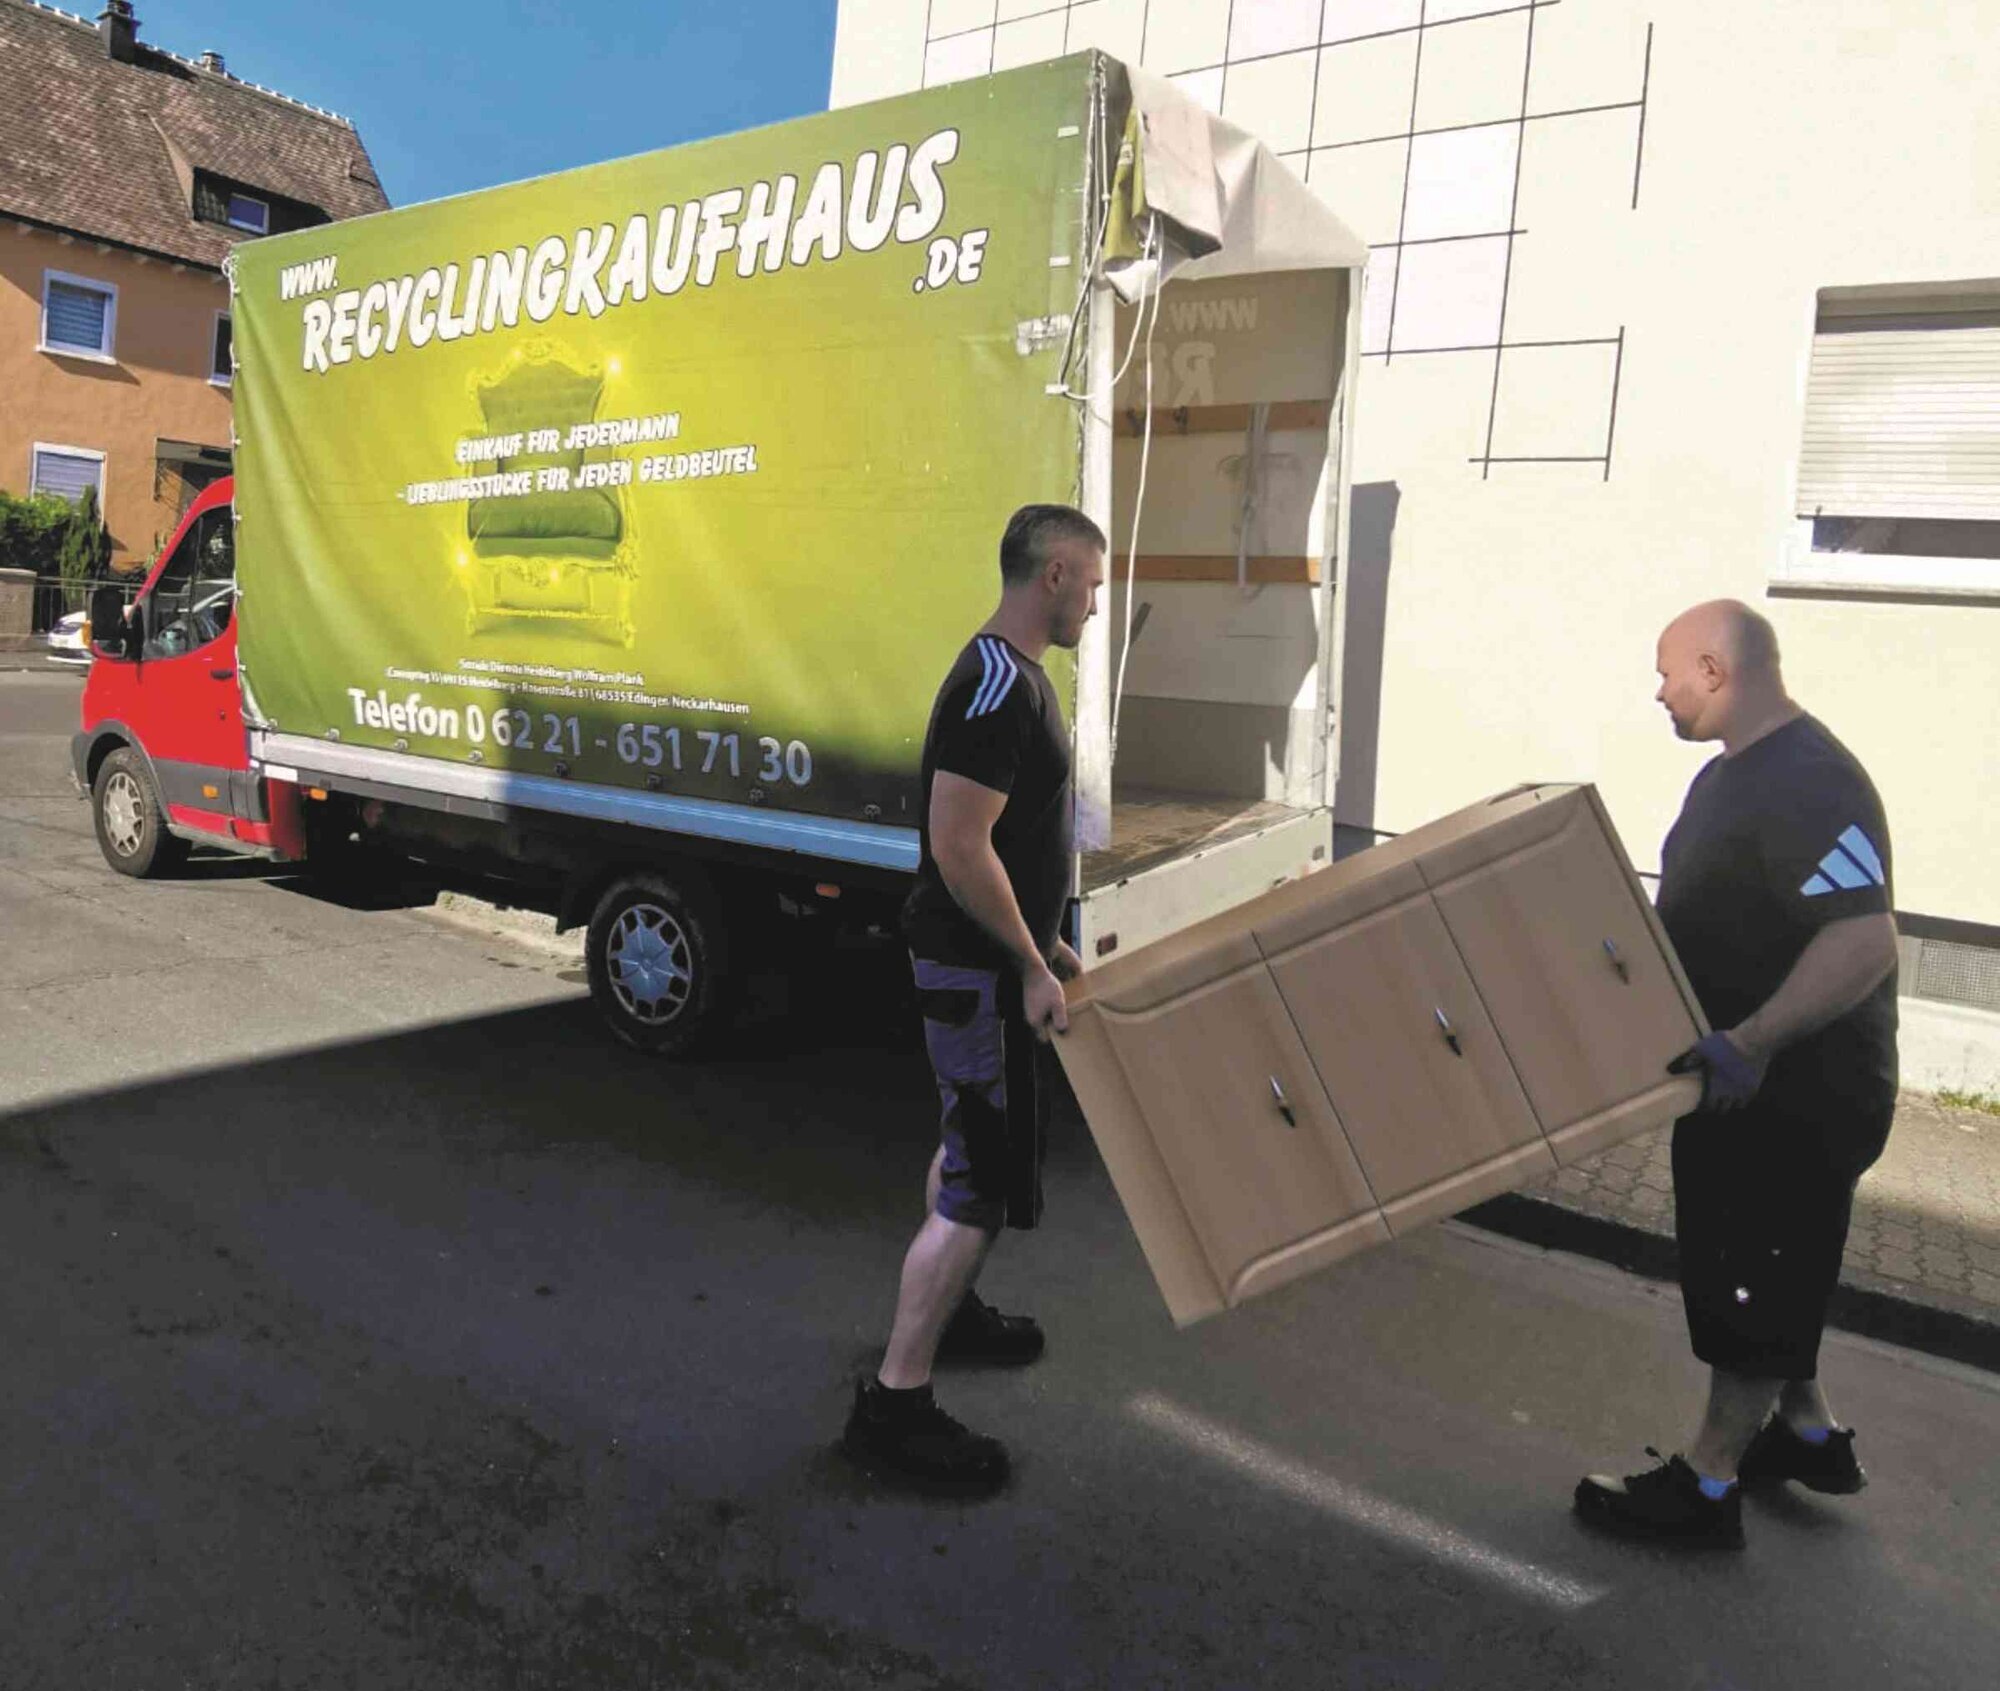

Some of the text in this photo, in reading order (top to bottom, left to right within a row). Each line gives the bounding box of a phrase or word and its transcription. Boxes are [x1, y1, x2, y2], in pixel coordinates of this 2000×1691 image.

[280, 253, 339, 301] WWW.
[302, 127, 961, 375] RECYCLINGKAUFHAUS
[912, 228, 990, 294] .DE
[455, 432, 524, 464] EINKAUF
[563, 412, 681, 450] JEDERMANN
[573, 458, 634, 489] JEDEN
[638, 444, 758, 483] GELDBEUTEL
[626, 690, 670, 709] Edingen
[671, 695, 750, 715] Neckarhausen
[347, 687, 460, 740] Telefon
[465, 703, 486, 744] 0
[491, 707, 534, 751] 62
[543, 712, 583, 757] 21
[615, 722, 682, 771] 651
[696, 730, 741, 778] 71
[758, 735, 814, 787] 30
